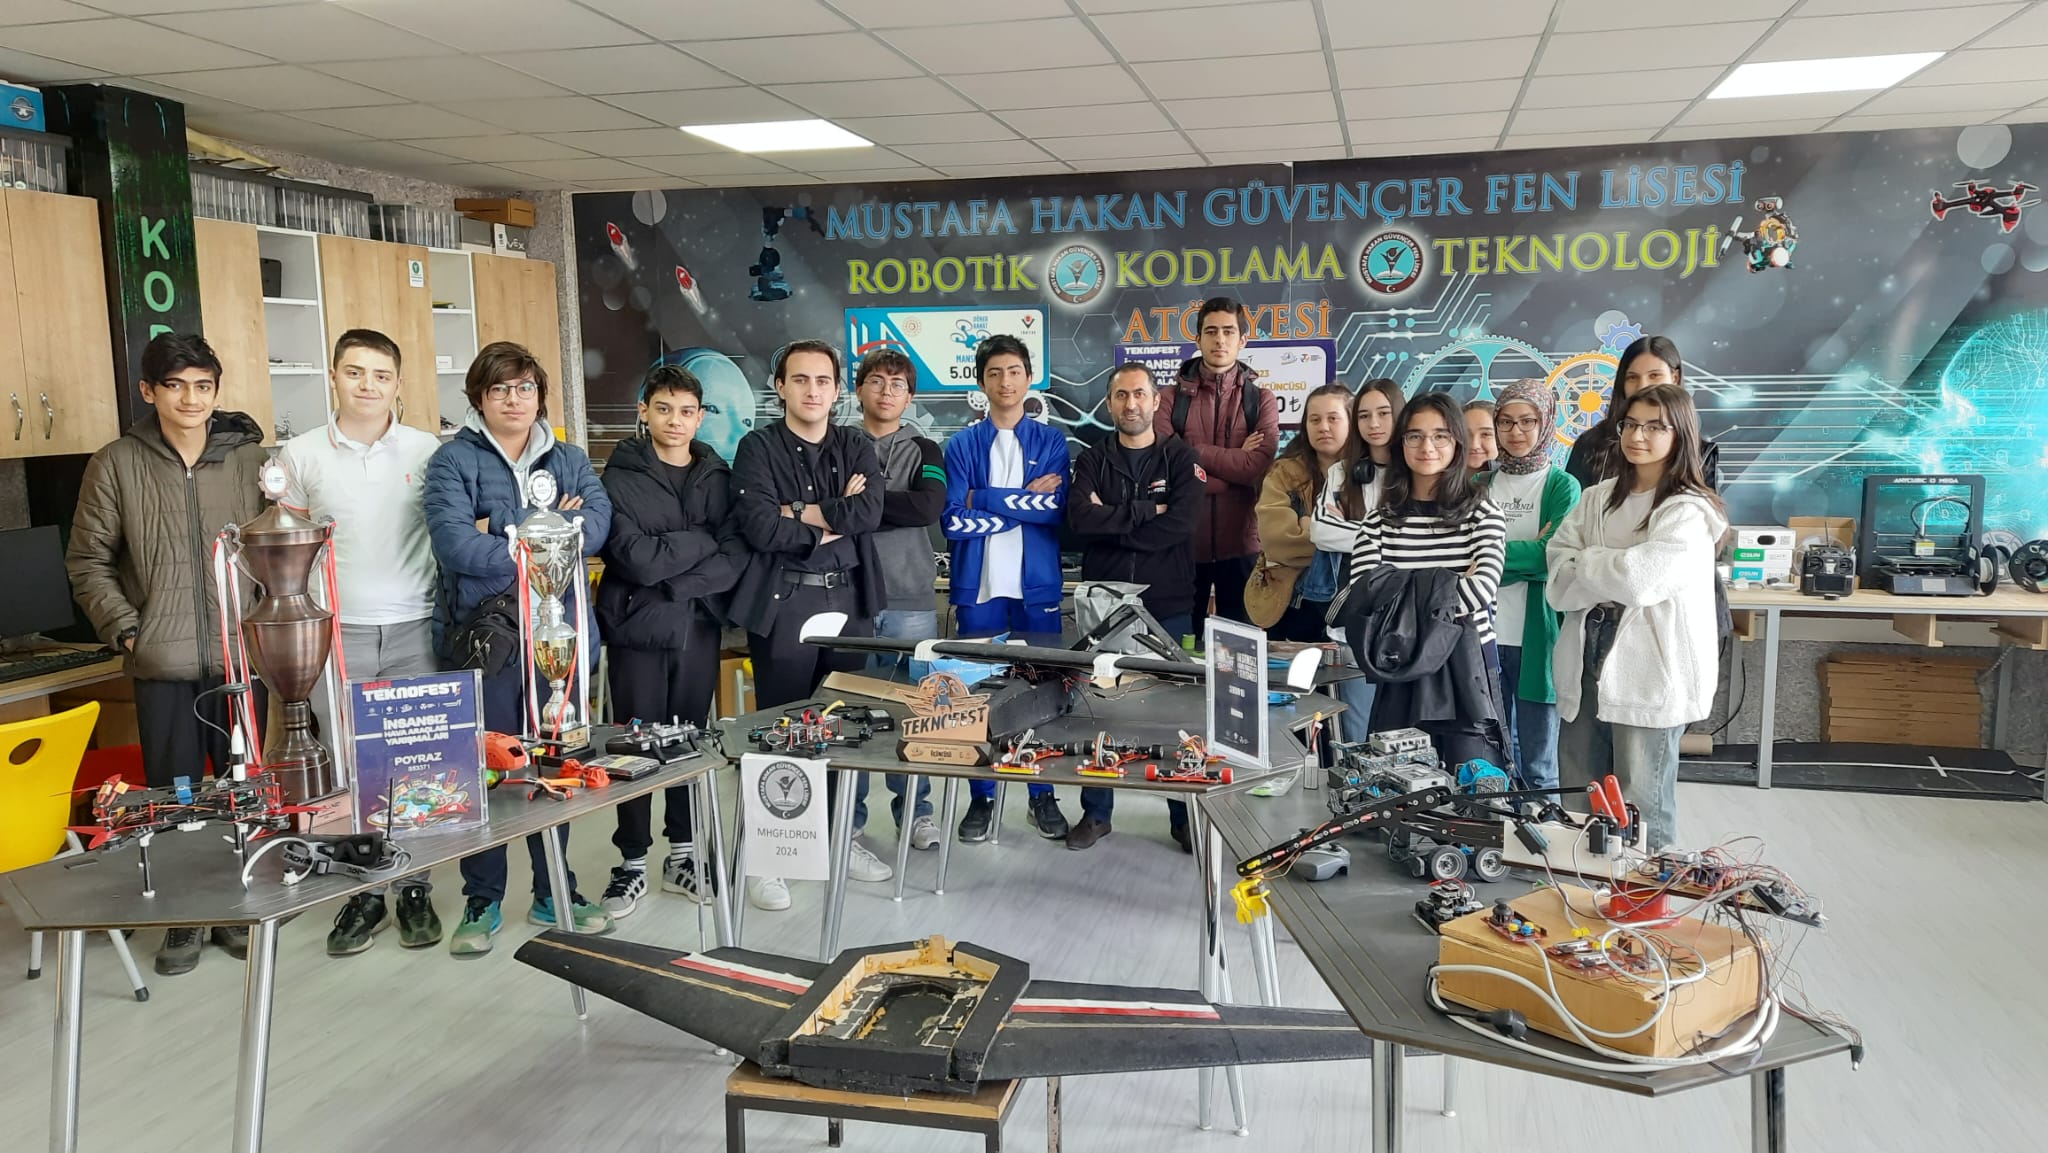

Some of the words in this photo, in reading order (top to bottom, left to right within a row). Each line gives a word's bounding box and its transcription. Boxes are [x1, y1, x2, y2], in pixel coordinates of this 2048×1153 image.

[825, 198, 1017, 240] MUSTAFA
[1031, 189, 1187, 233] HAKAN
[1203, 176, 1472, 227] GÜVENÇER
[1484, 169, 1581, 214] FEN
[1599, 160, 1747, 209] LİSESİ
[847, 254, 1039, 294] ROBOTİK
[1115, 241, 1347, 287] KODLAMA
[1432, 223, 1721, 279] TEKNOLOJİ
[1120, 298, 1333, 343] ATÖYESİ
[956, 354, 977, 363] MANS
[1124, 346, 1181, 355] TEKNOFEST
[362, 681, 462, 702] TEKNOFEST
[383, 713, 448, 731] İNSANSIZ
[394, 751, 443, 766] POYRAZ
[757, 828, 816, 840] MHGFLDRON
[776, 846, 797, 856] 2024
